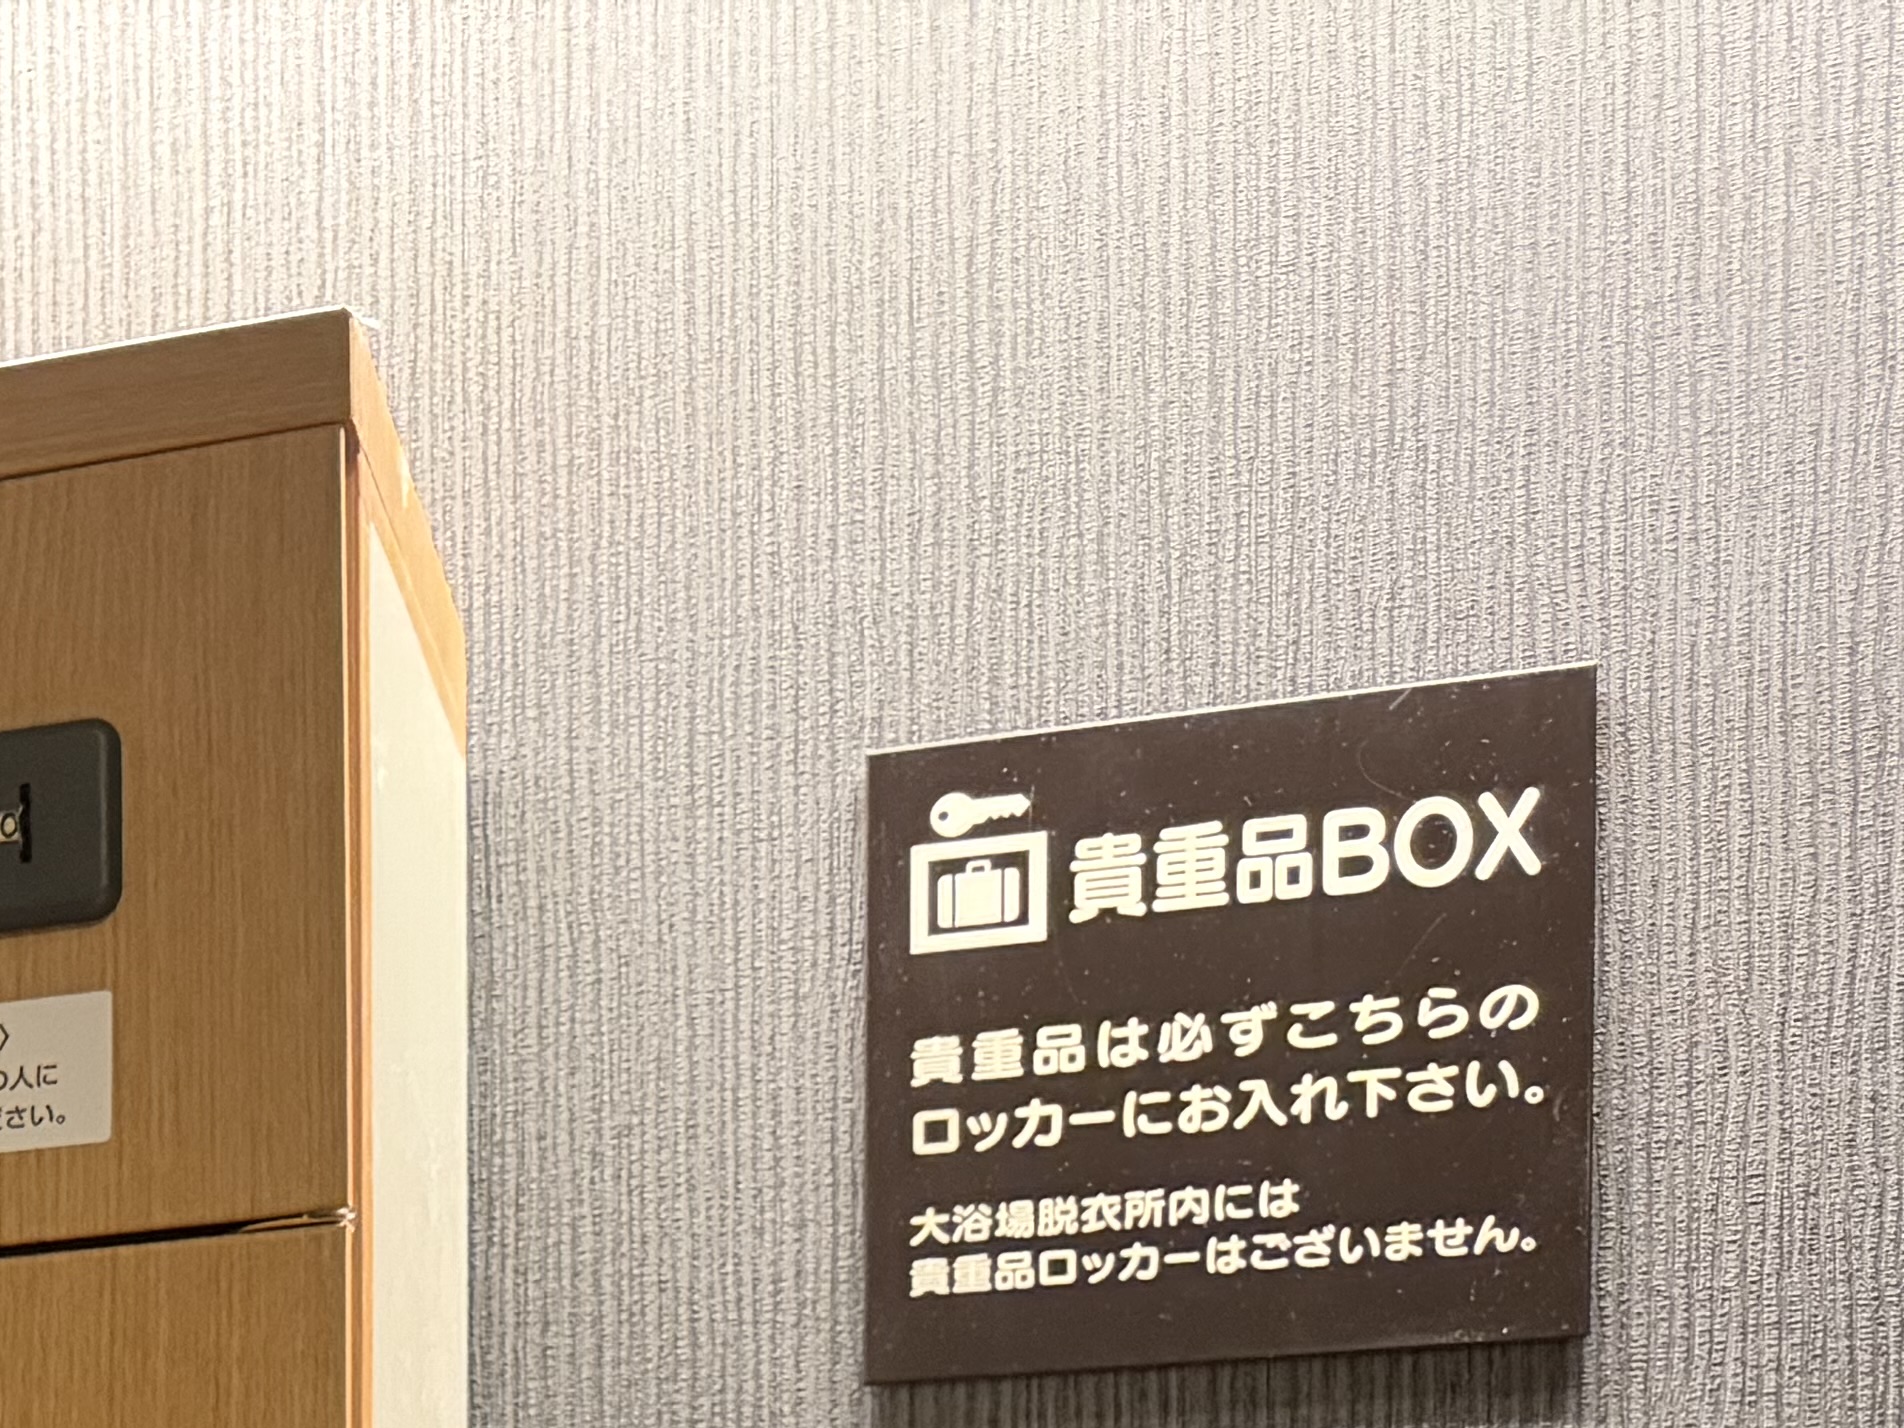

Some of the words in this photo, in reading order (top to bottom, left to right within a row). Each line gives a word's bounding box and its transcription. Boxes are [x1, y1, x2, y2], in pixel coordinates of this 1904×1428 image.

[1070, 787, 1542, 923] 貴重品BOX
[911, 984, 1540, 1088] 貴重品は必ずこちらの
[912, 1060, 1544, 1155] ロッカーにお入れ下さい。
[910, 1179, 1300, 1247] 大浴場脱衣所内には
[910, 1216, 1537, 1298] 貴重品ロッカーはございません。
